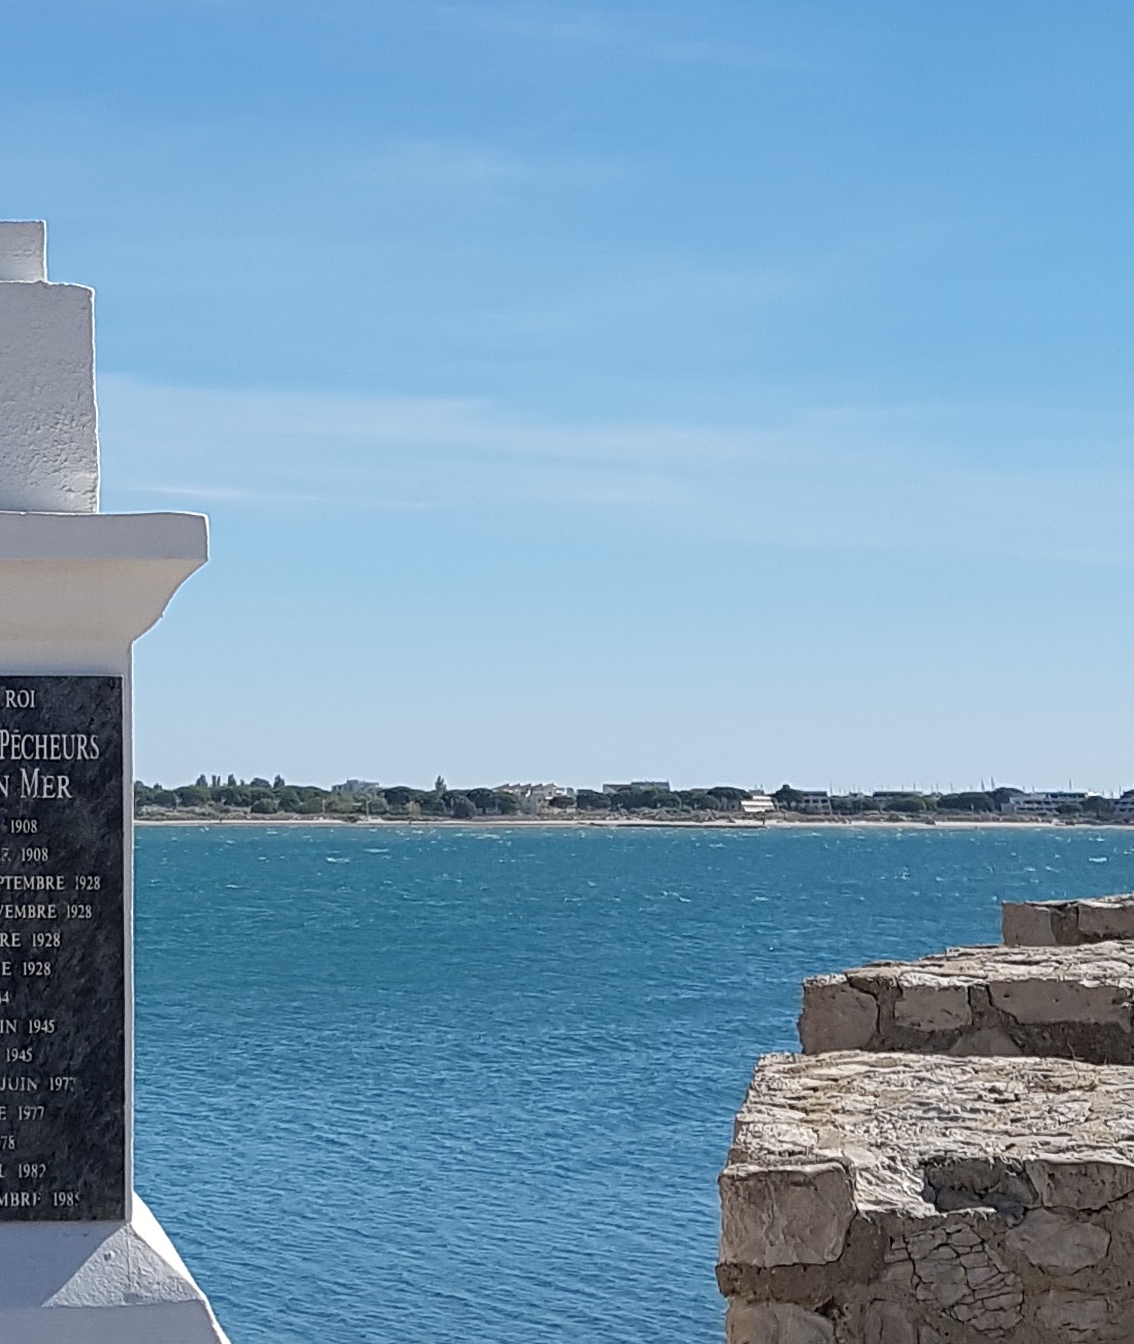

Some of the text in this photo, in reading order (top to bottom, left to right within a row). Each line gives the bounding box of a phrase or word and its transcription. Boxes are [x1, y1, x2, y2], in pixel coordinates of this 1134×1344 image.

[4, 689, 36, 709] ROI
[20, 767, 73, 799] MER
[10, 819, 38, 834] 1908
[21, 848, 49, 862] 1908
[75, 876, 101, 890] 1928
[66, 904, 93, 919] 1928
[32, 932, 61, 947] 1928
[22, 961, 52, 976] 1928
[29, 1019, 55, 1034] 1945
[6, 1048, 33, 1063] 1945
[0, 1076, 38, 1092] JUIN
[18, 1106, 46, 1121] 1977
